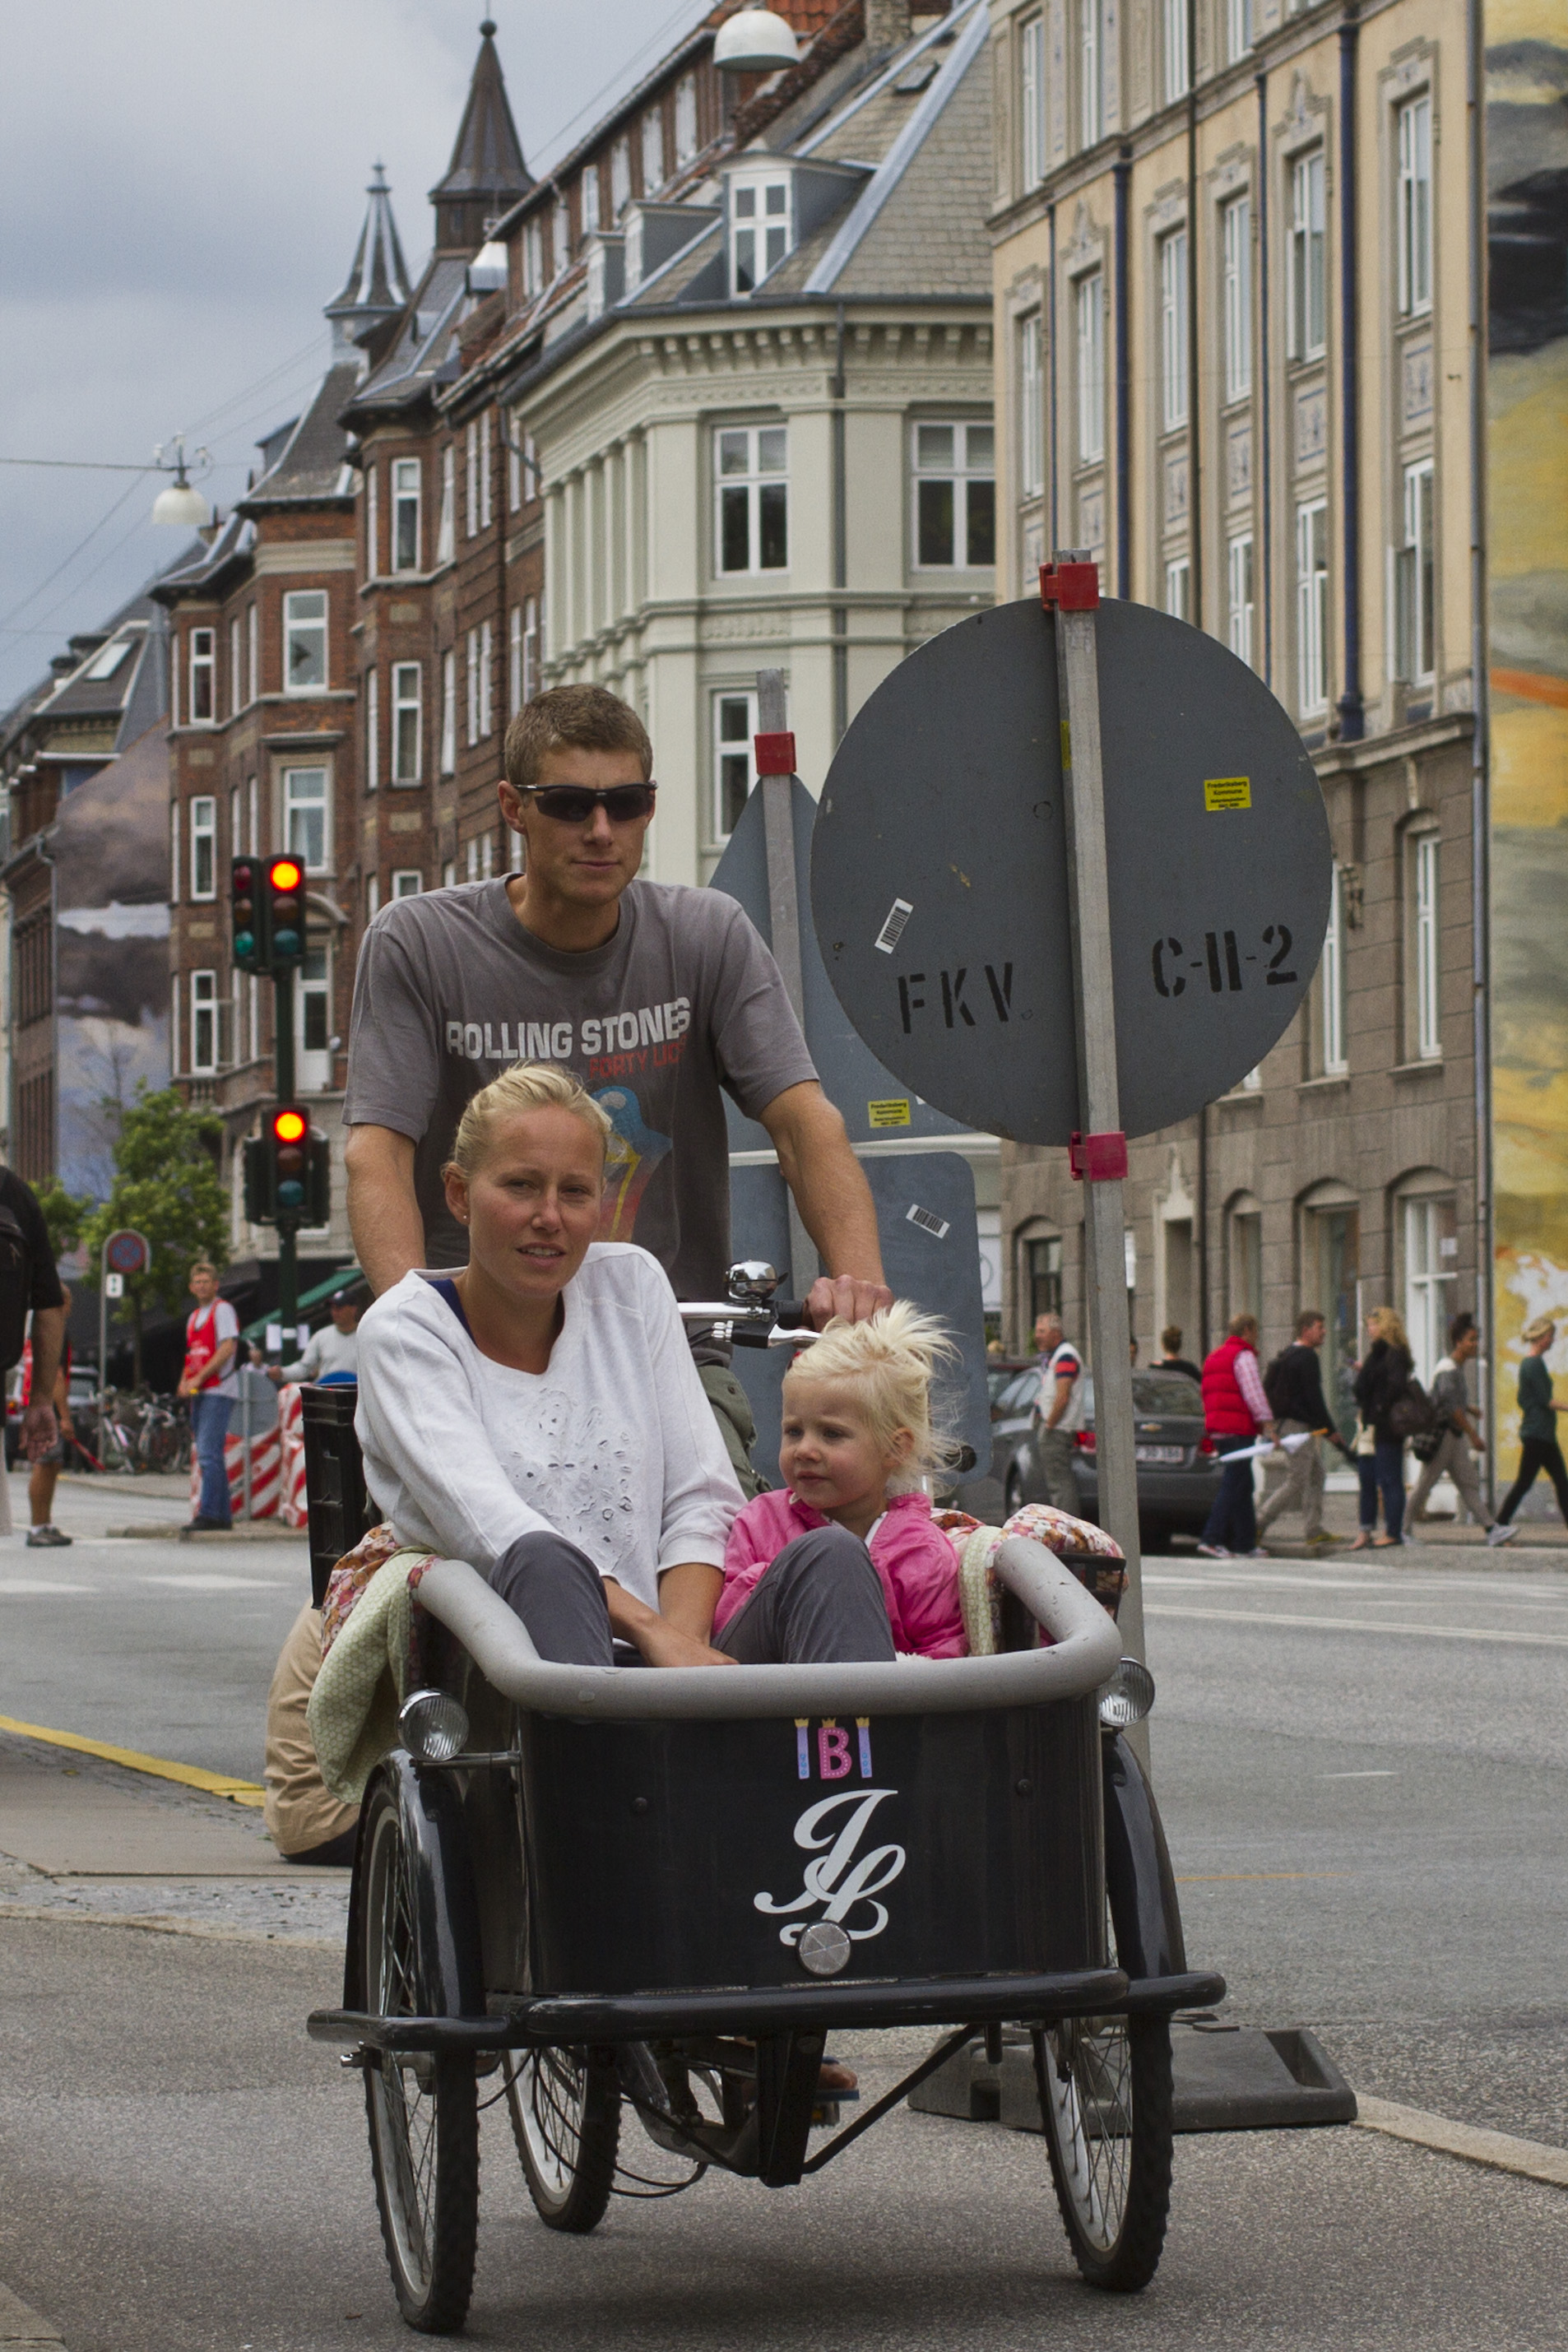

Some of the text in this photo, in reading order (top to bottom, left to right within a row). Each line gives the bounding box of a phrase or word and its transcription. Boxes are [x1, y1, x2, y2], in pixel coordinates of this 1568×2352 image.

[447, 996, 690, 1060] ROLLING STONES
[898, 962, 1013, 1034] FKV
[589, 1049, 647, 1079] FORTY
